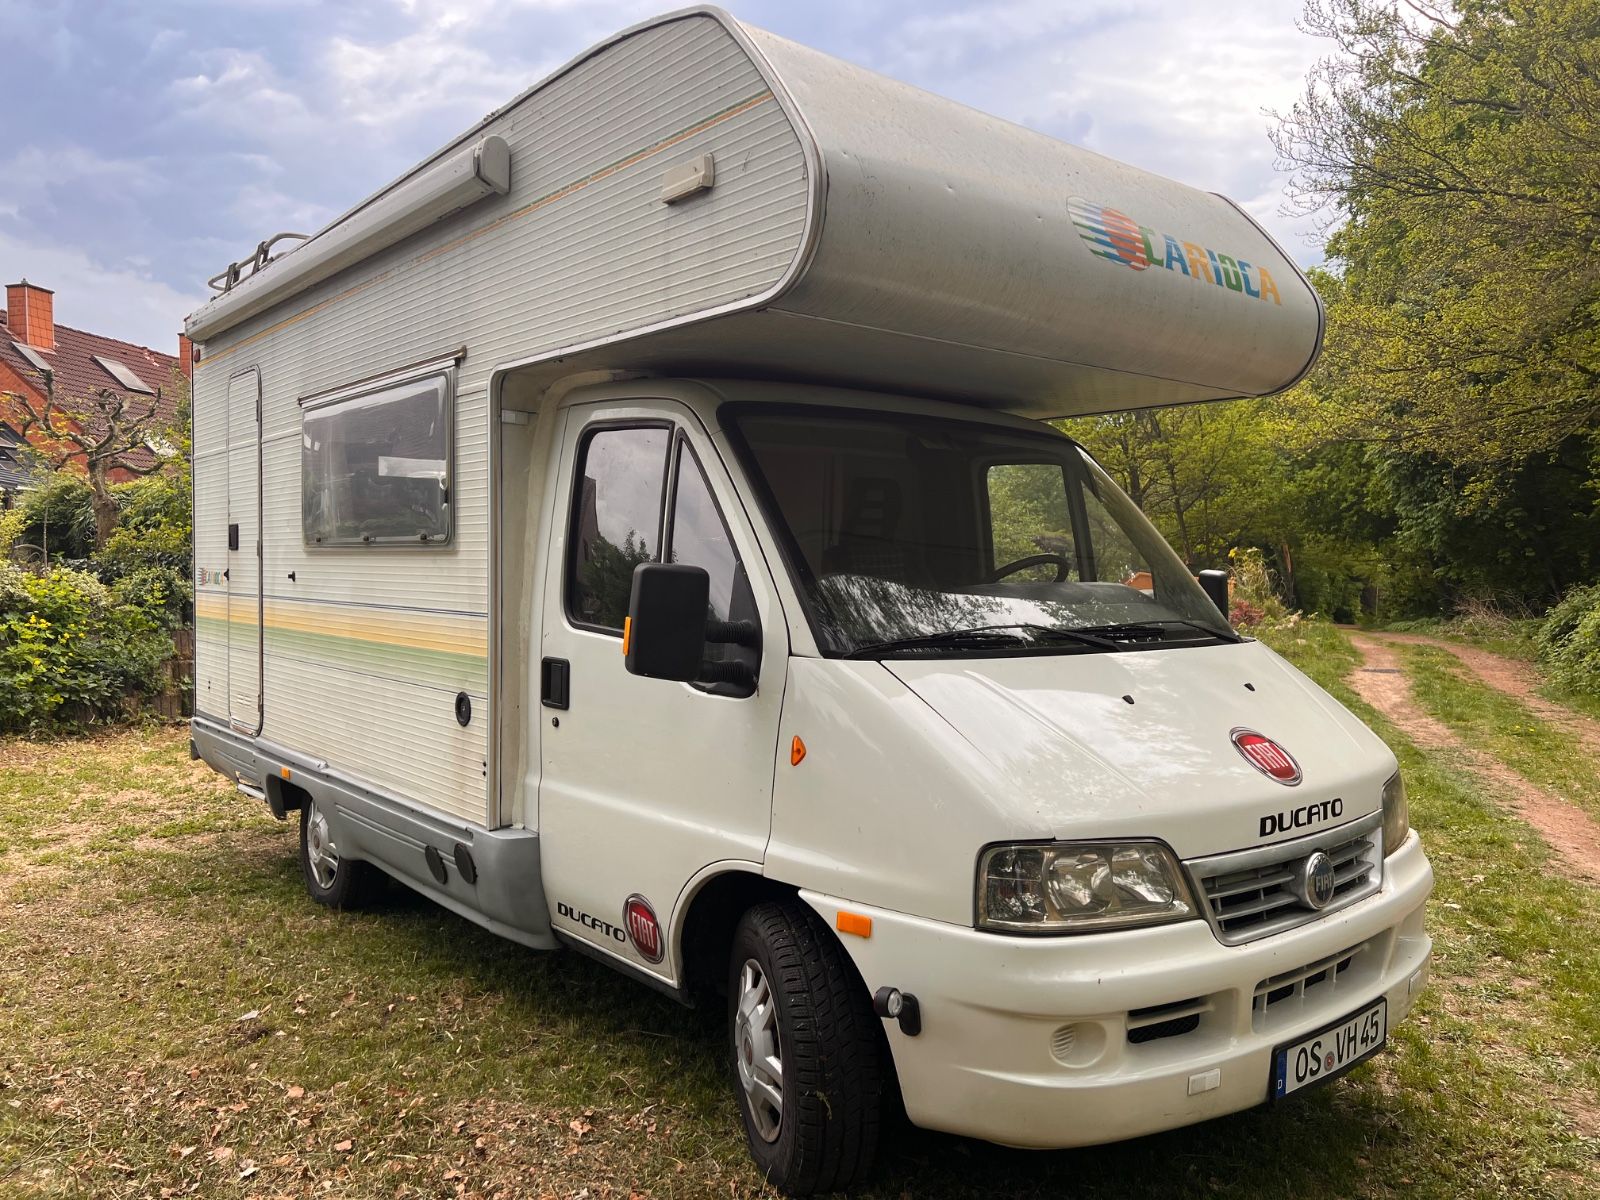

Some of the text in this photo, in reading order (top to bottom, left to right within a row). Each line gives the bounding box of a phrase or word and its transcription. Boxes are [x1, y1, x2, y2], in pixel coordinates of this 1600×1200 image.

[1138, 224, 1282, 306] CARIOCA
[1244, 741, 1289, 770] FIAT
[1259, 797, 1344, 838] DUCATO
[1315, 873, 1333, 893] FIAT
[557, 901, 626, 943] DUCATO
[631, 911, 656, 949] FIAT
[1295, 1040, 1322, 1083] OS
